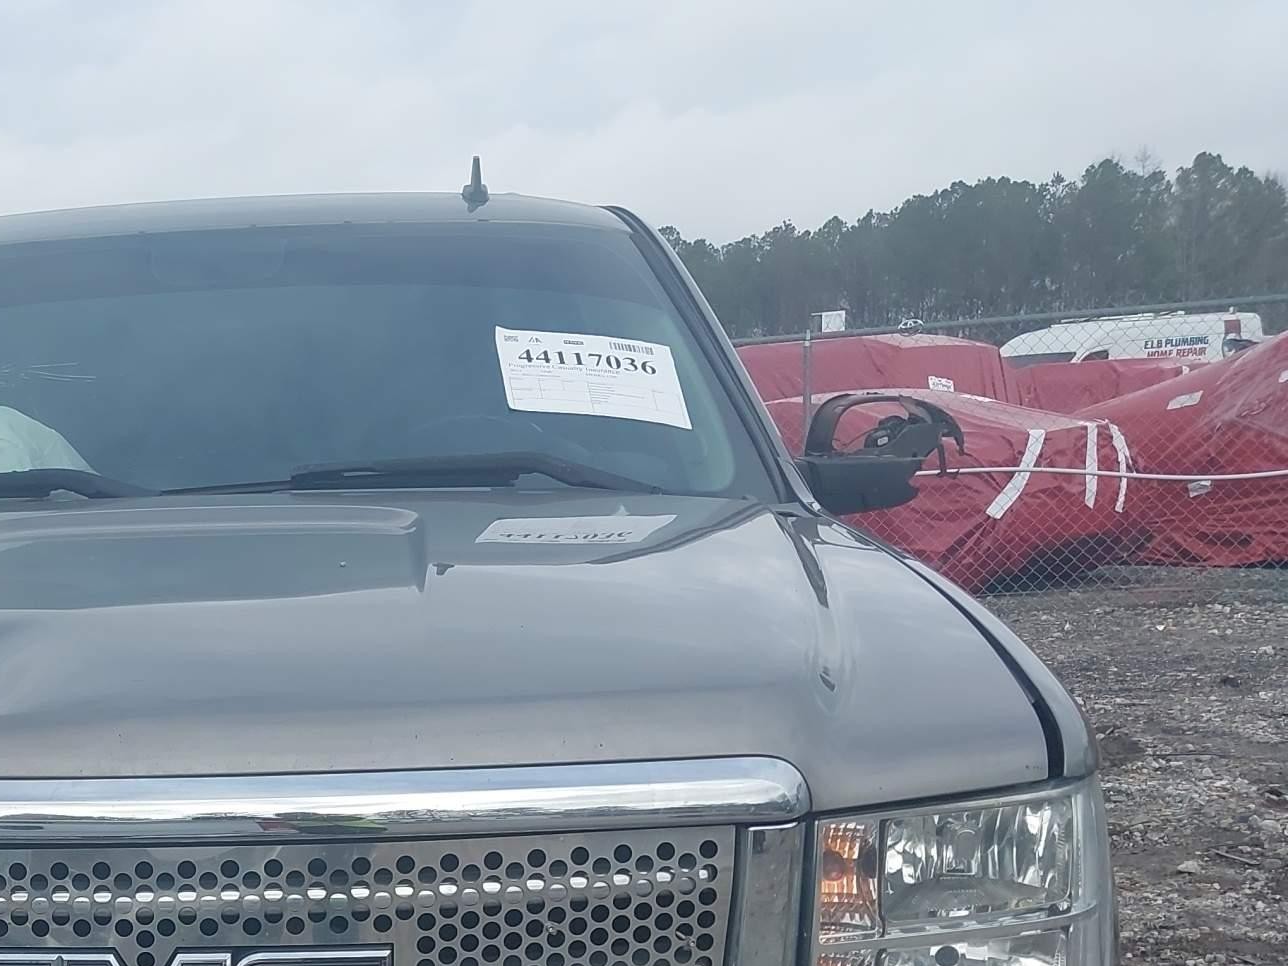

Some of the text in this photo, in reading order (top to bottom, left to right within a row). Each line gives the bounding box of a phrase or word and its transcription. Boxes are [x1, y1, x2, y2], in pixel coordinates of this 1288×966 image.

[1164, 336, 1209, 347] PLUMBING
[1175, 347, 1207, 357] REPAIR
[517, 348, 657, 376] 44117036
